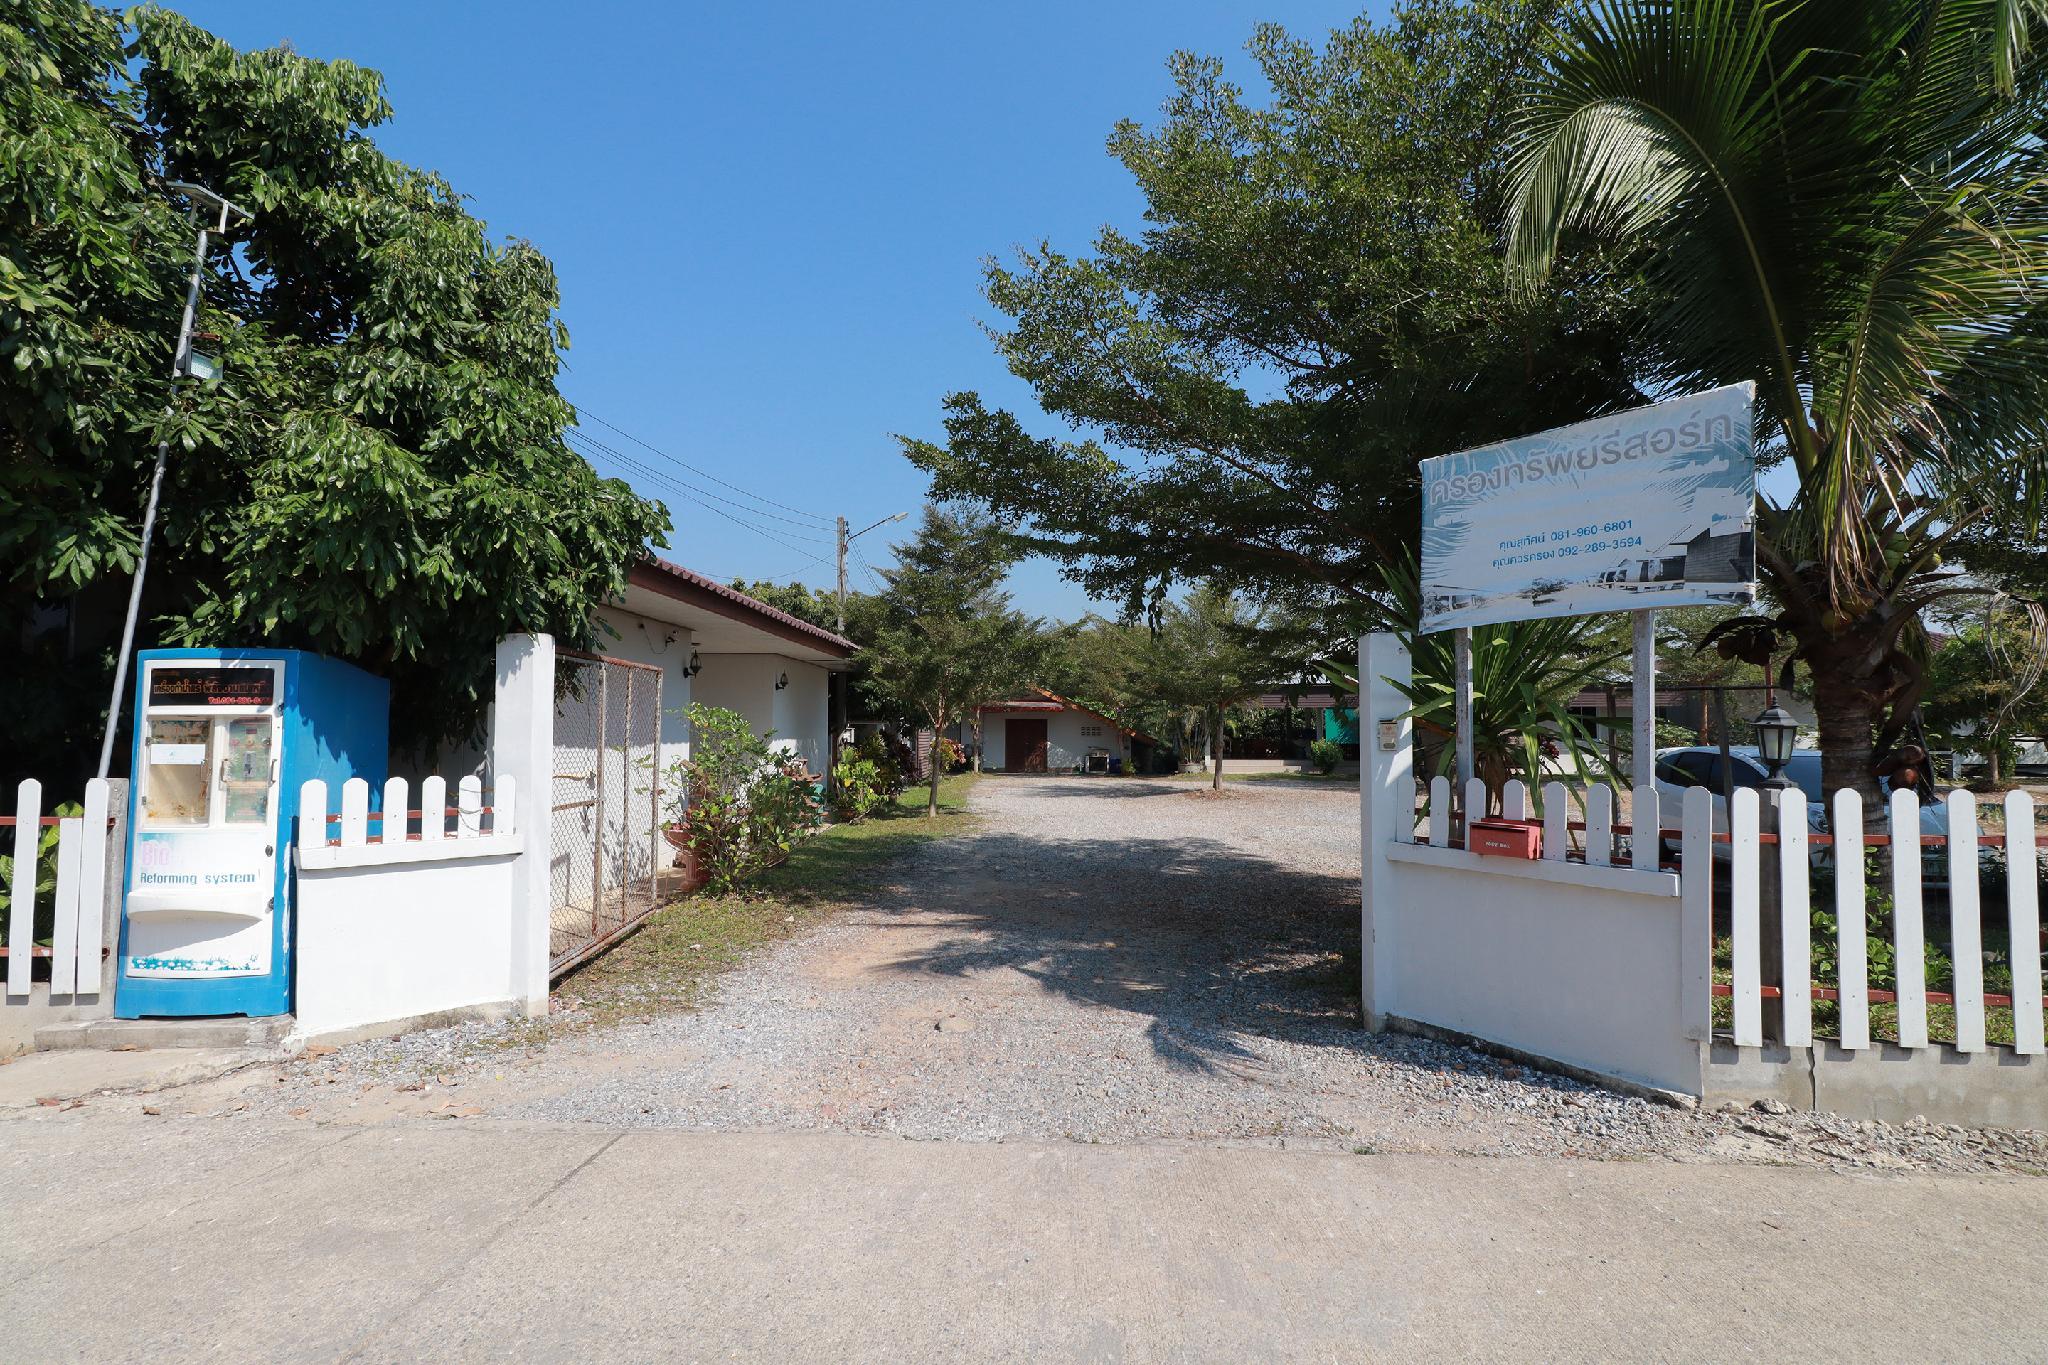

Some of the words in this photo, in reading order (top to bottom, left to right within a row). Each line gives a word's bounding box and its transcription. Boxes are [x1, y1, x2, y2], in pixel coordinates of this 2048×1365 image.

[1430, 410, 1732, 504] ครองทรัพย์รีสอร์ท
[1550, 519, 1633, 541] 081-960-6801
[140, 872, 198, 885] Reforming
[205, 873, 256, 885] system
